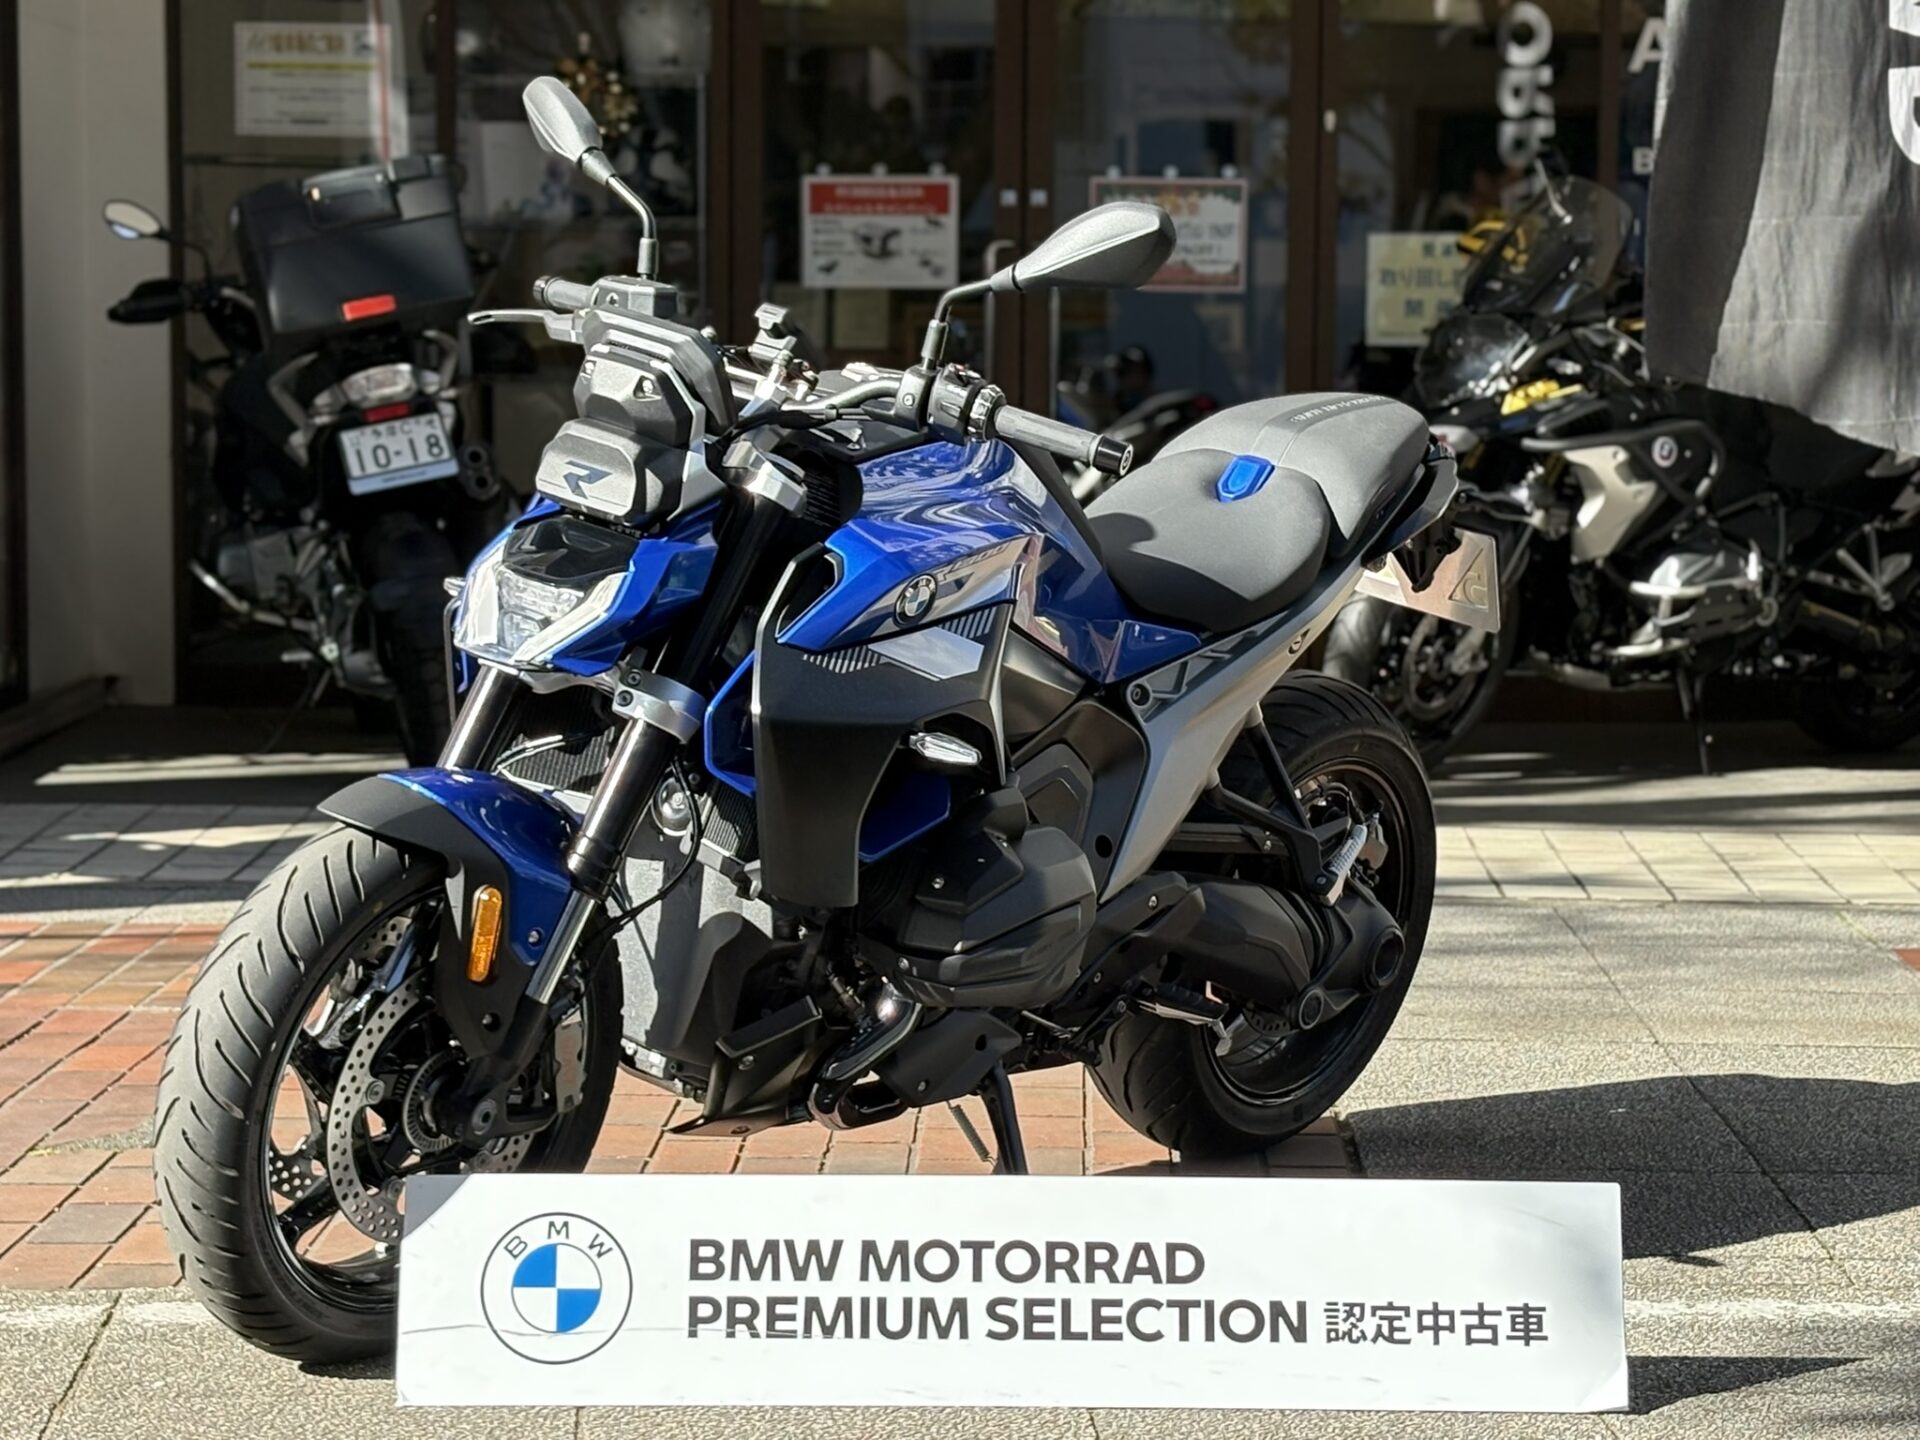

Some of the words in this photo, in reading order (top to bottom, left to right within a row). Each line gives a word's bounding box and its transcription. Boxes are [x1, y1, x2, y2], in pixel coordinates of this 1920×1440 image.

[355, 433, 444, 473] 10-18
[503, 1220, 614, 1260] BMW
[689, 1239, 843, 1282] BMW
[859, 1239, 1205, 1285] MOTORRAD
[687, 1296, 969, 1341] PREMIUM
[985, 1297, 1307, 1343] SELECTION
[1323, 1301, 1549, 1347] 認定中古車
